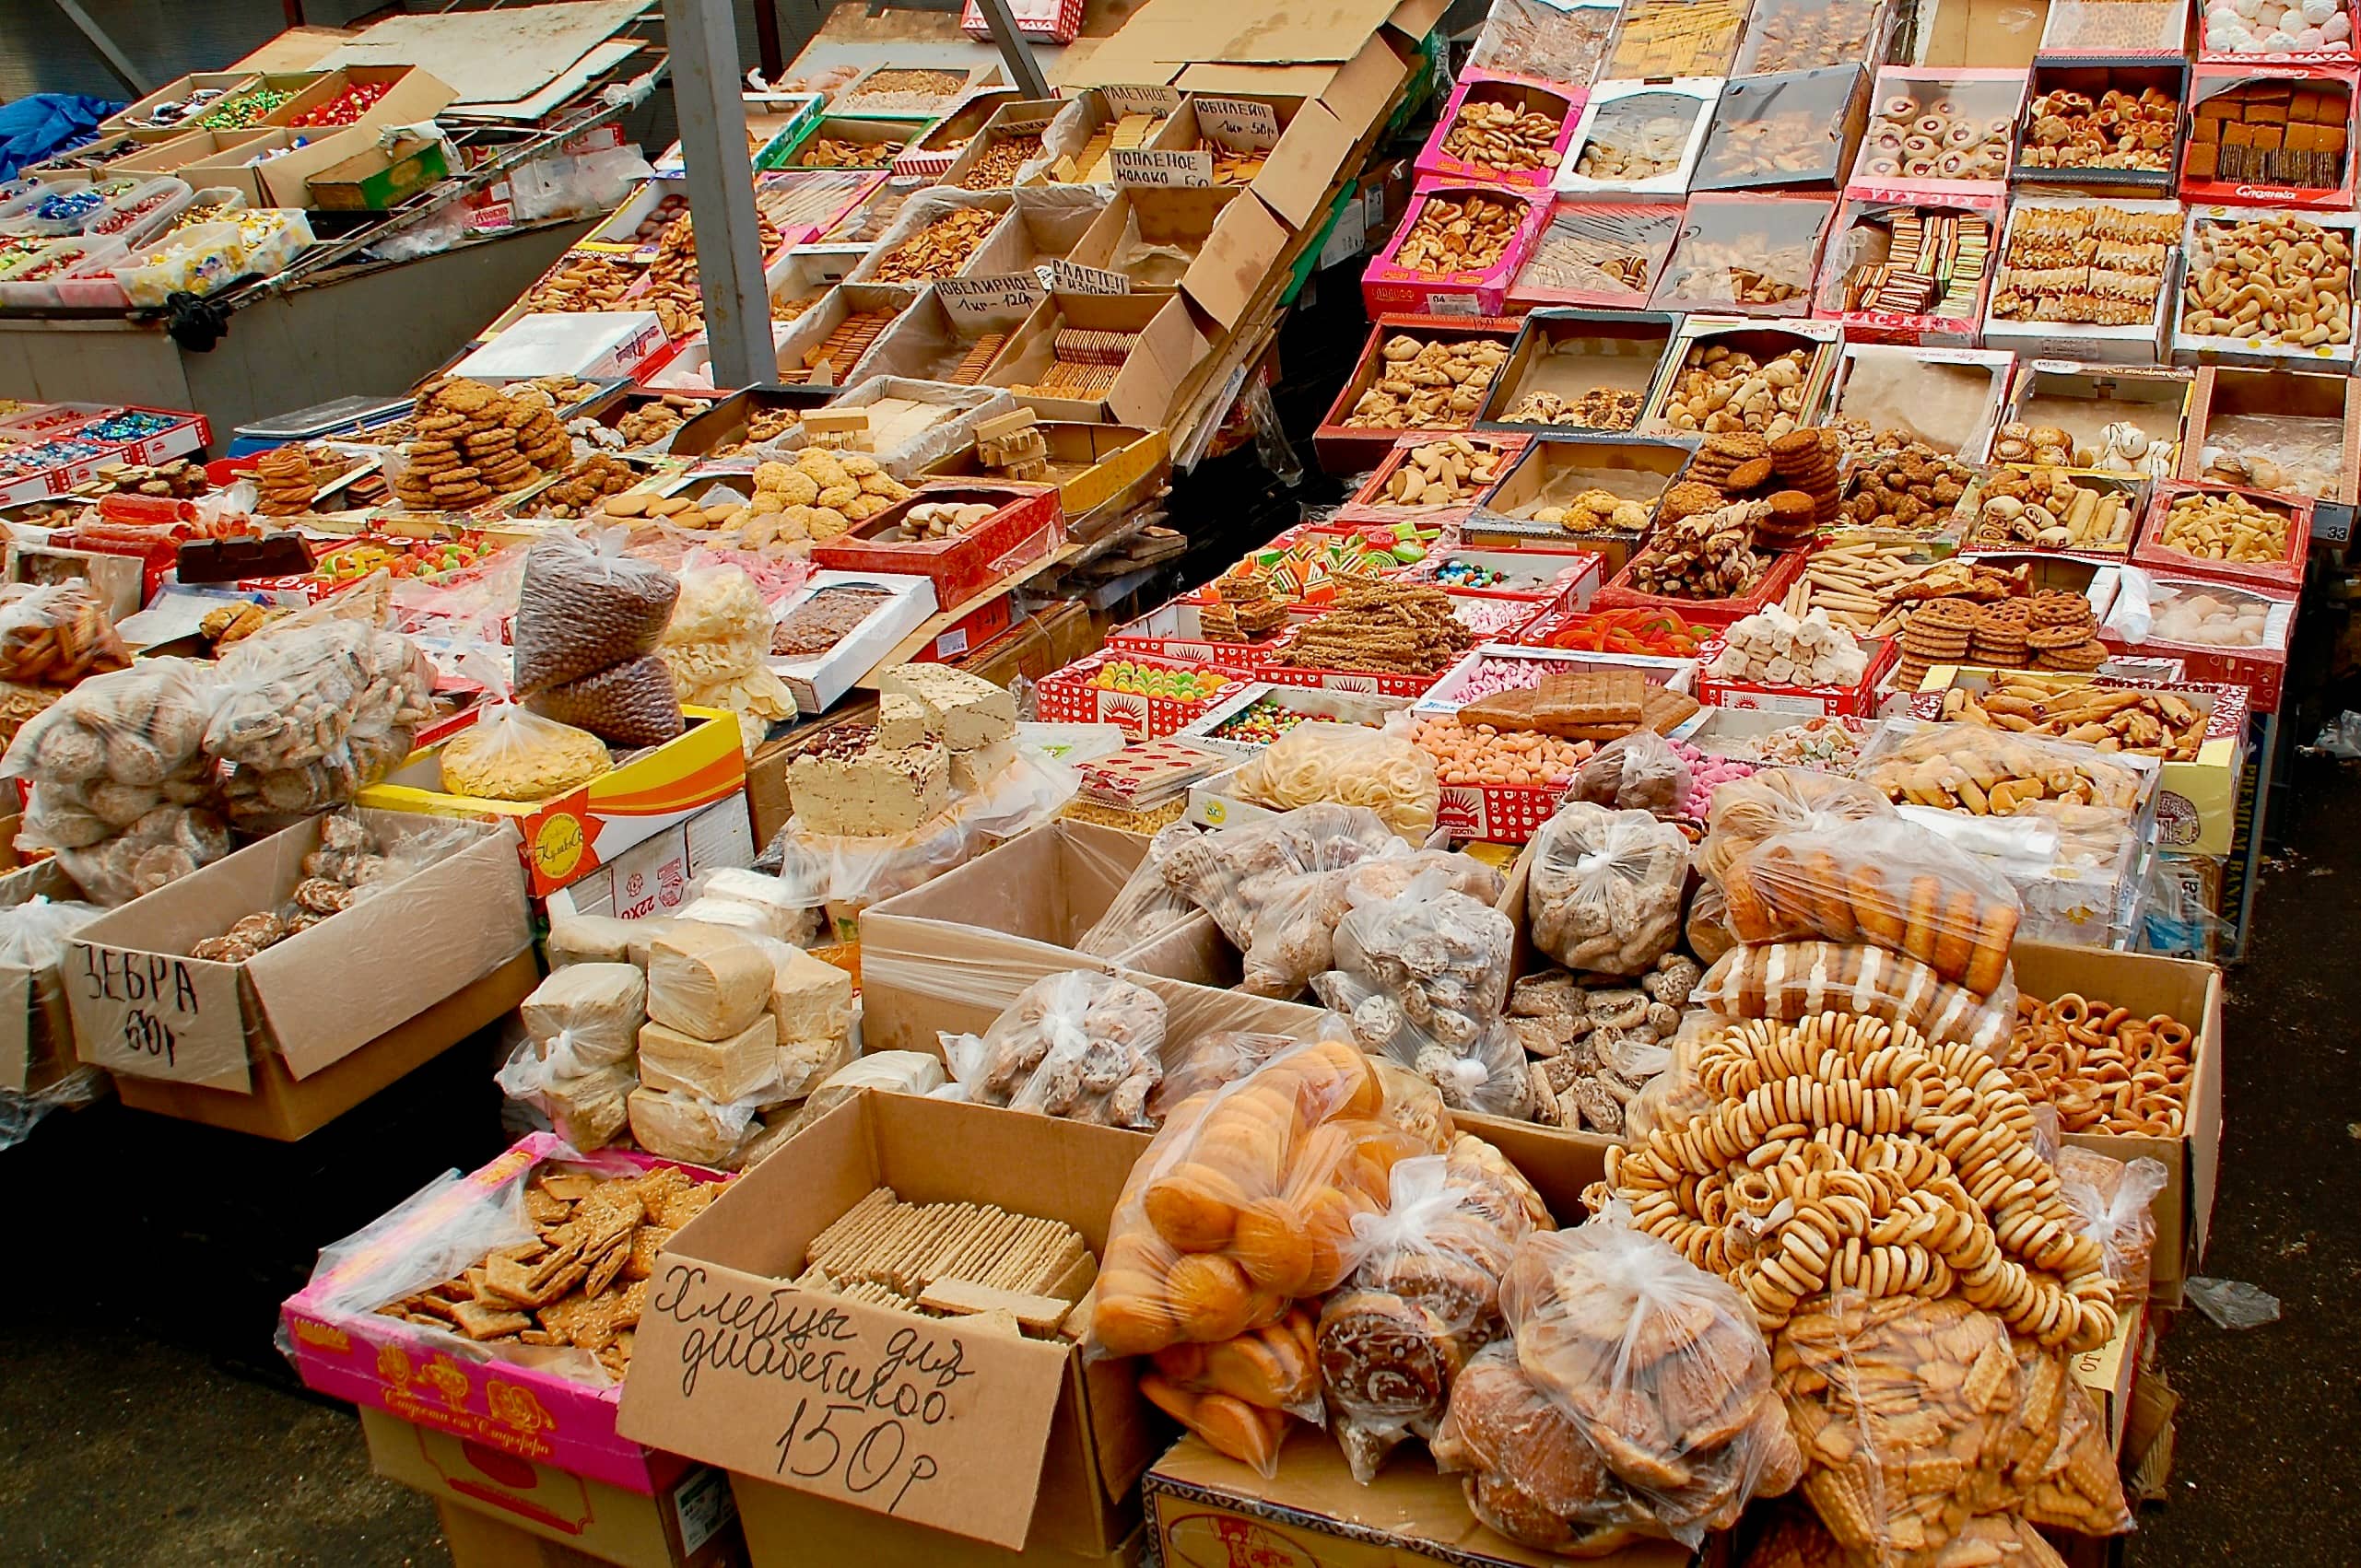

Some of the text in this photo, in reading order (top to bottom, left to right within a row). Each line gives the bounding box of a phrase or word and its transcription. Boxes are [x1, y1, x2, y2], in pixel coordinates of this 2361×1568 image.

[1115, 152, 1198, 170] ТОПЛЕНОЕ
[935, 276, 1039, 297] ЮВЕЛИРНОЕ
[2327, 525, 2347, 541] 33
[2222, 764, 2257, 925] PREMIUM BANAN
[74, 942, 199, 1015] ЗЕБРА
[655, 1265, 858, 1351] Хлебцы
